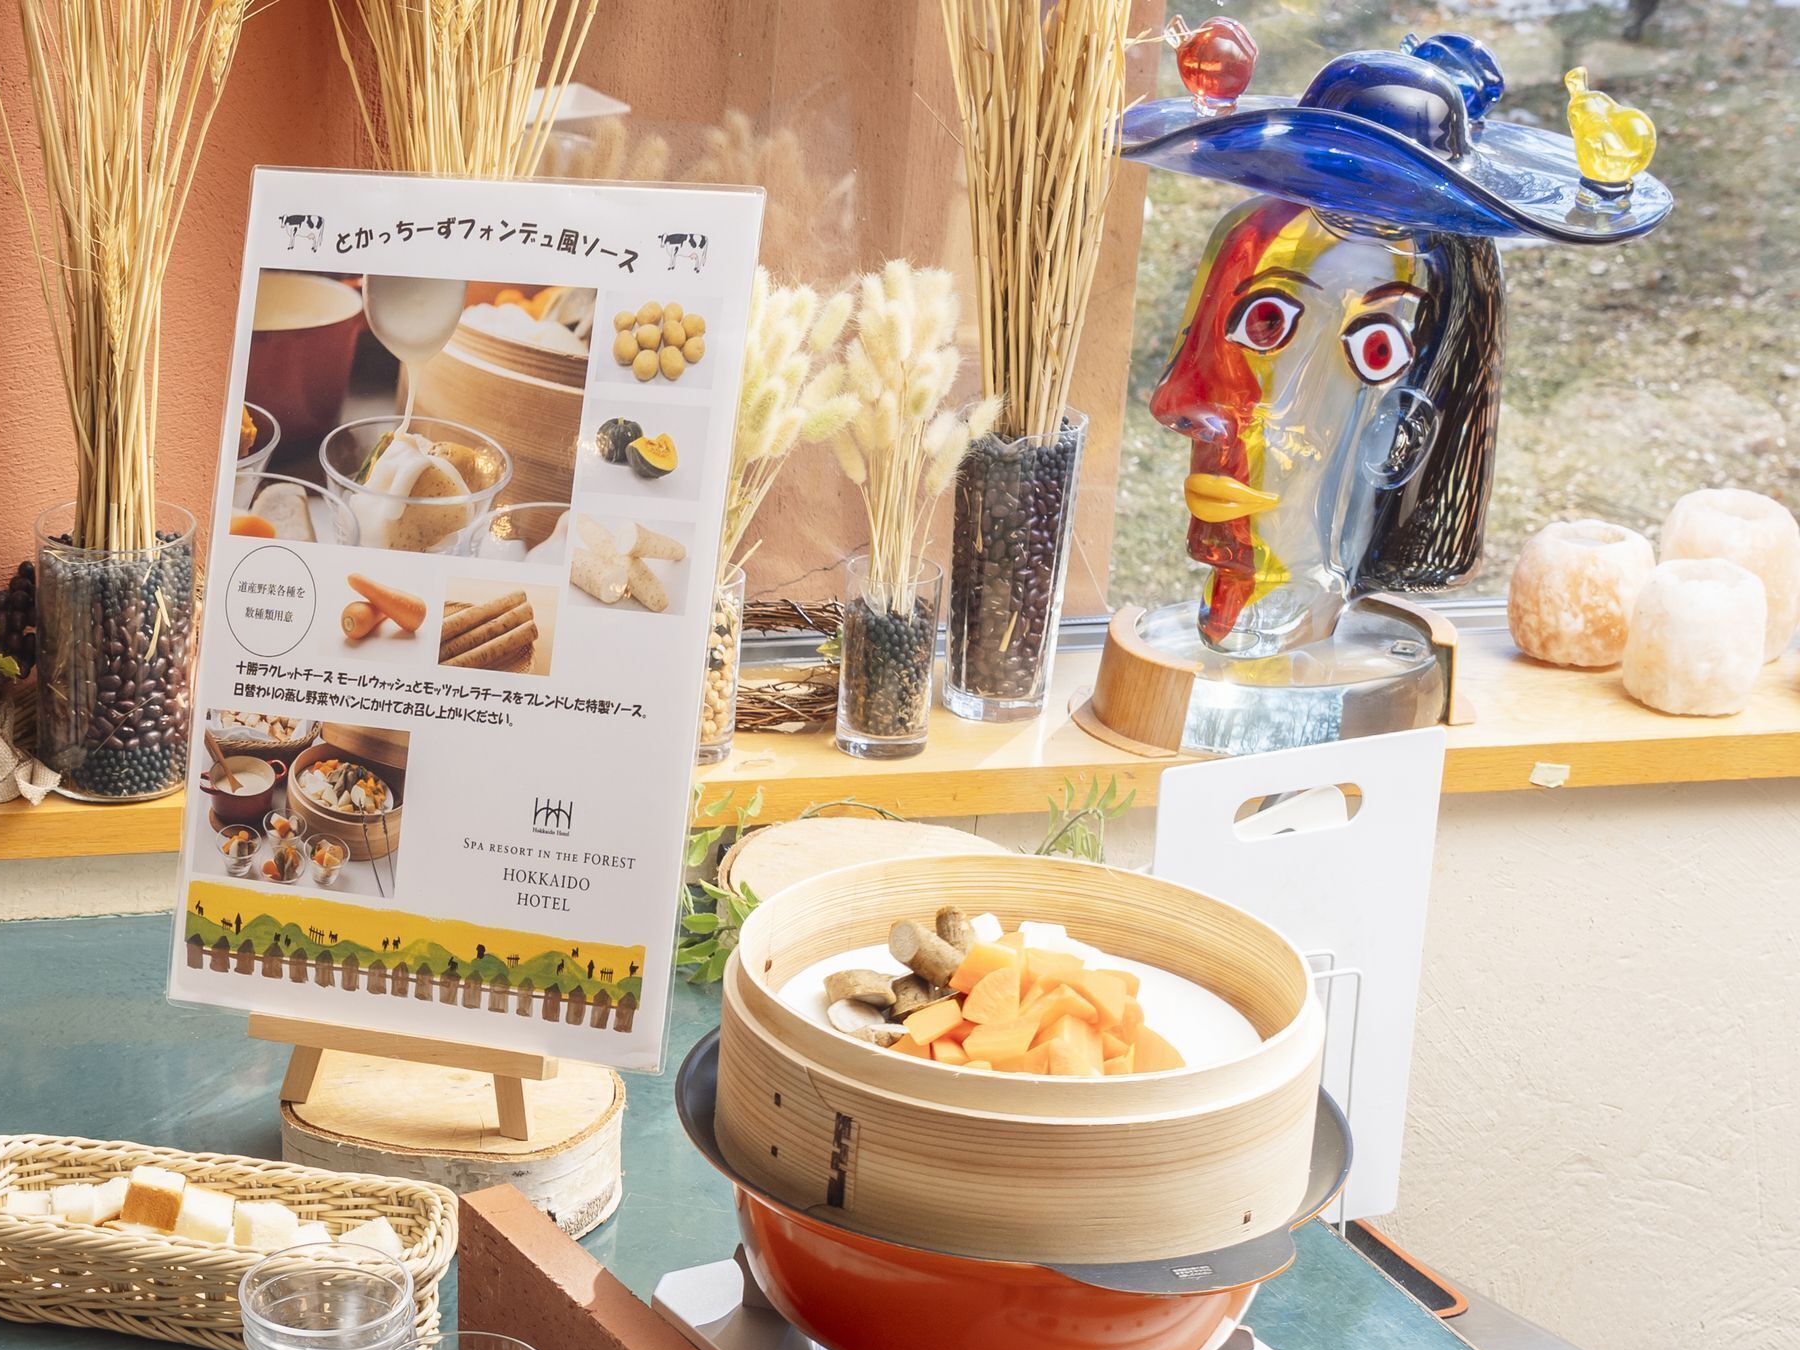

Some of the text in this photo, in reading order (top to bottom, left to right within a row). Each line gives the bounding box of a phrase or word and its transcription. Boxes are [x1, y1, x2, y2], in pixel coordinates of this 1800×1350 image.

[335, 216, 639, 273] とかっちーずフォンデュ風ソース
[238, 580, 306, 599] 道産野菜各種を
[245, 606, 294, 623] 数種類用意
[235, 660, 647, 719] 十勝ラクレットチーズ モールウォッシュとモッツァレラチーズをブレンドした特製ソース。
[233, 682, 514, 727] 日替わりの蒸し野菜やパンにかけてお召し上がりください。
[583, 852, 637, 870] FOREST
[502, 867, 591, 892] HOKKAIDO
[516, 892, 571, 912] HOTEL
